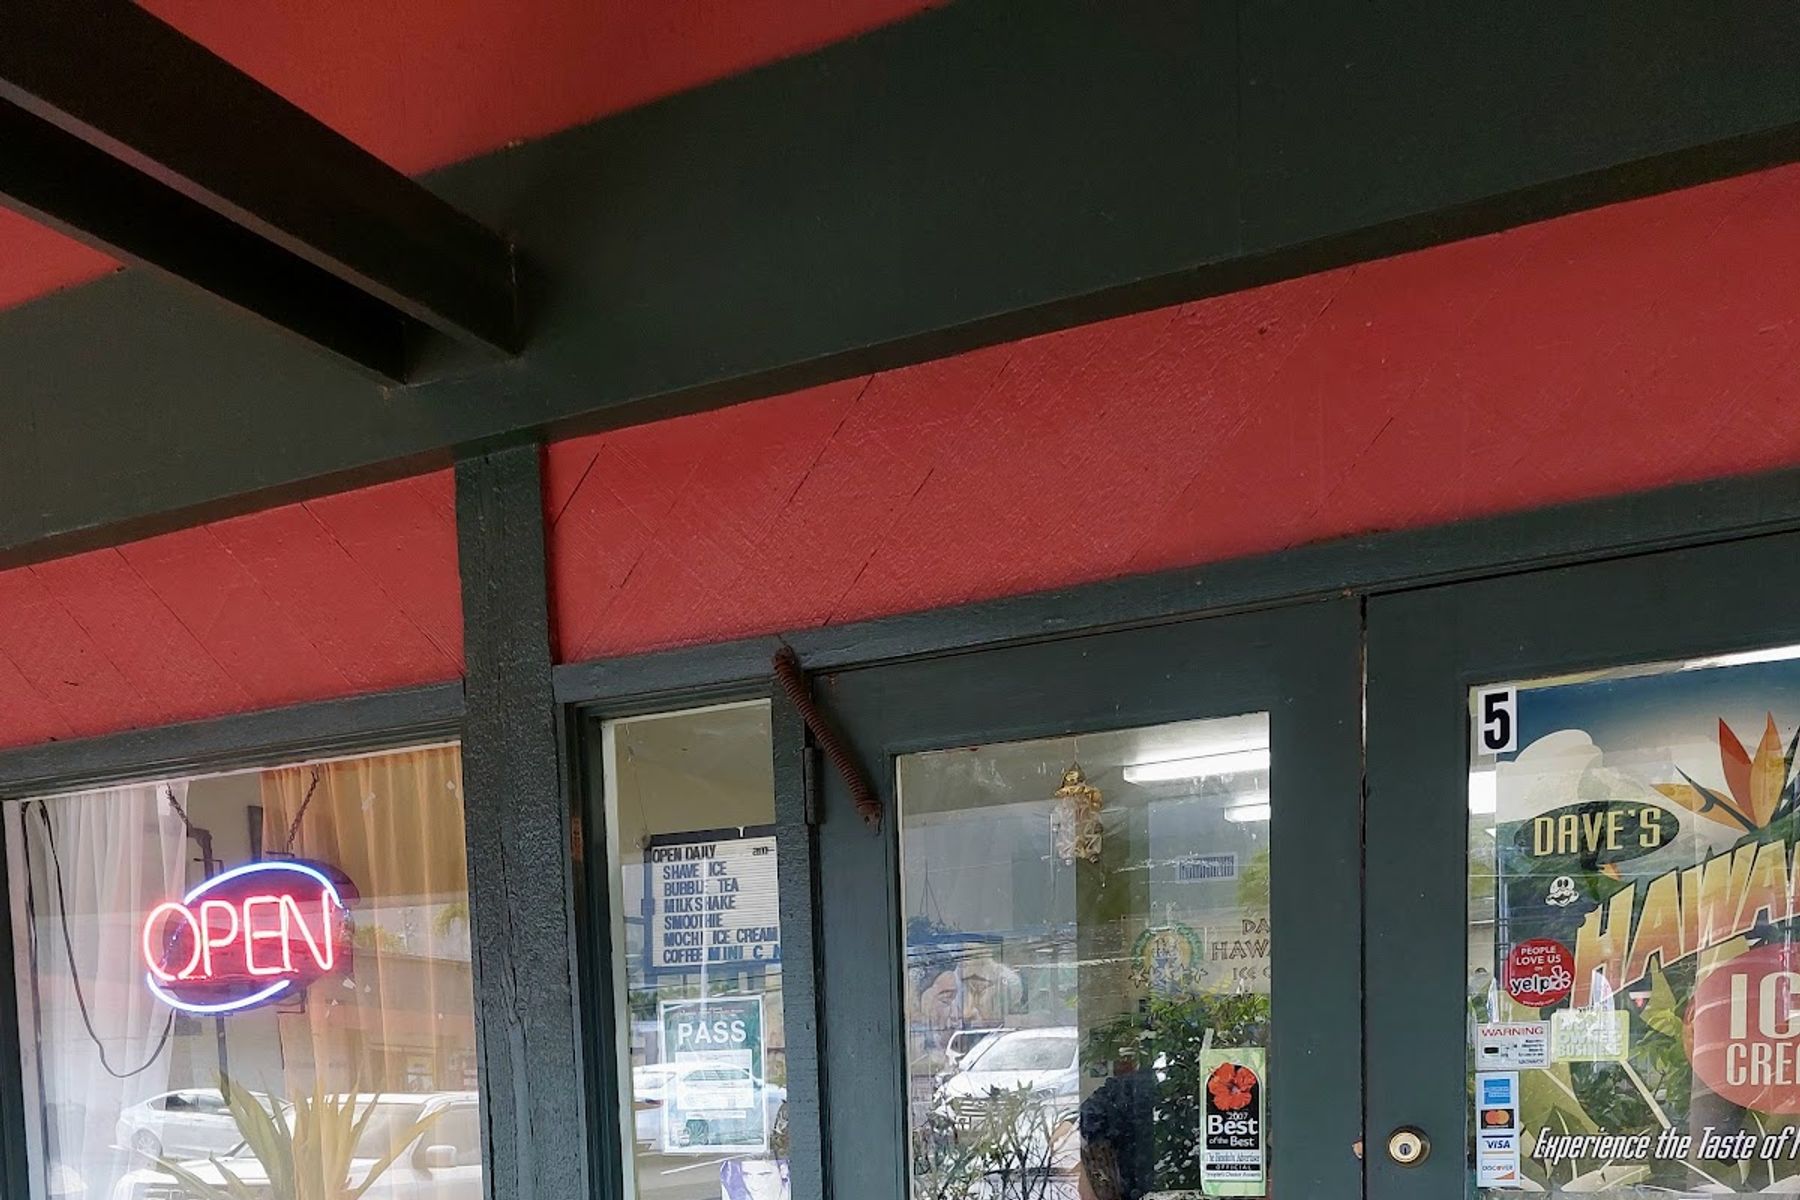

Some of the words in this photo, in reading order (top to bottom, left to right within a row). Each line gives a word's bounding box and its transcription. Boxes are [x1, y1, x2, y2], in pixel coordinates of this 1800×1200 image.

[1484, 691, 1510, 750] 5
[1534, 808, 1661, 856] DAVE'S
[652, 847, 682, 863] OPEN
[685, 844, 717, 860] DAILY
[663, 863, 700, 880] SHAVE
[708, 861, 727, 876] ICE
[664, 880, 709, 896] BUBBLE
[718, 878, 740, 893] TEA
[664, 913, 723, 930] SMOOTHIE
[143, 889, 334, 981] OPEN
[664, 931, 703, 947] MOCHI
[712, 930, 731, 944] ICE
[736, 927, 778, 943] CREAM
[708, 946, 743, 960] MINI
[1521, 945, 1556, 955] PEOPLE
[1516, 955, 1545, 966] LOVE
[1547, 954, 1561, 963] US
[1510, 974, 1551, 995] yelp
[678, 1020, 747, 1045] PASS
[1482, 1026, 1544, 1037] WARNING
[1726, 1042, 1800, 1086] CRE
[1207, 1114, 1258, 1135] Best
[1208, 1136, 1218, 1144] of
[1230, 1135, 1255, 1147] Best
[1486, 1140, 1511, 1149] VISA
[1533, 1126, 1650, 1166] Experience
[1655, 1126, 1692, 1159] the
[1696, 1126, 1757, 1159] Taste
[1760, 1125, 1795, 1159] of
